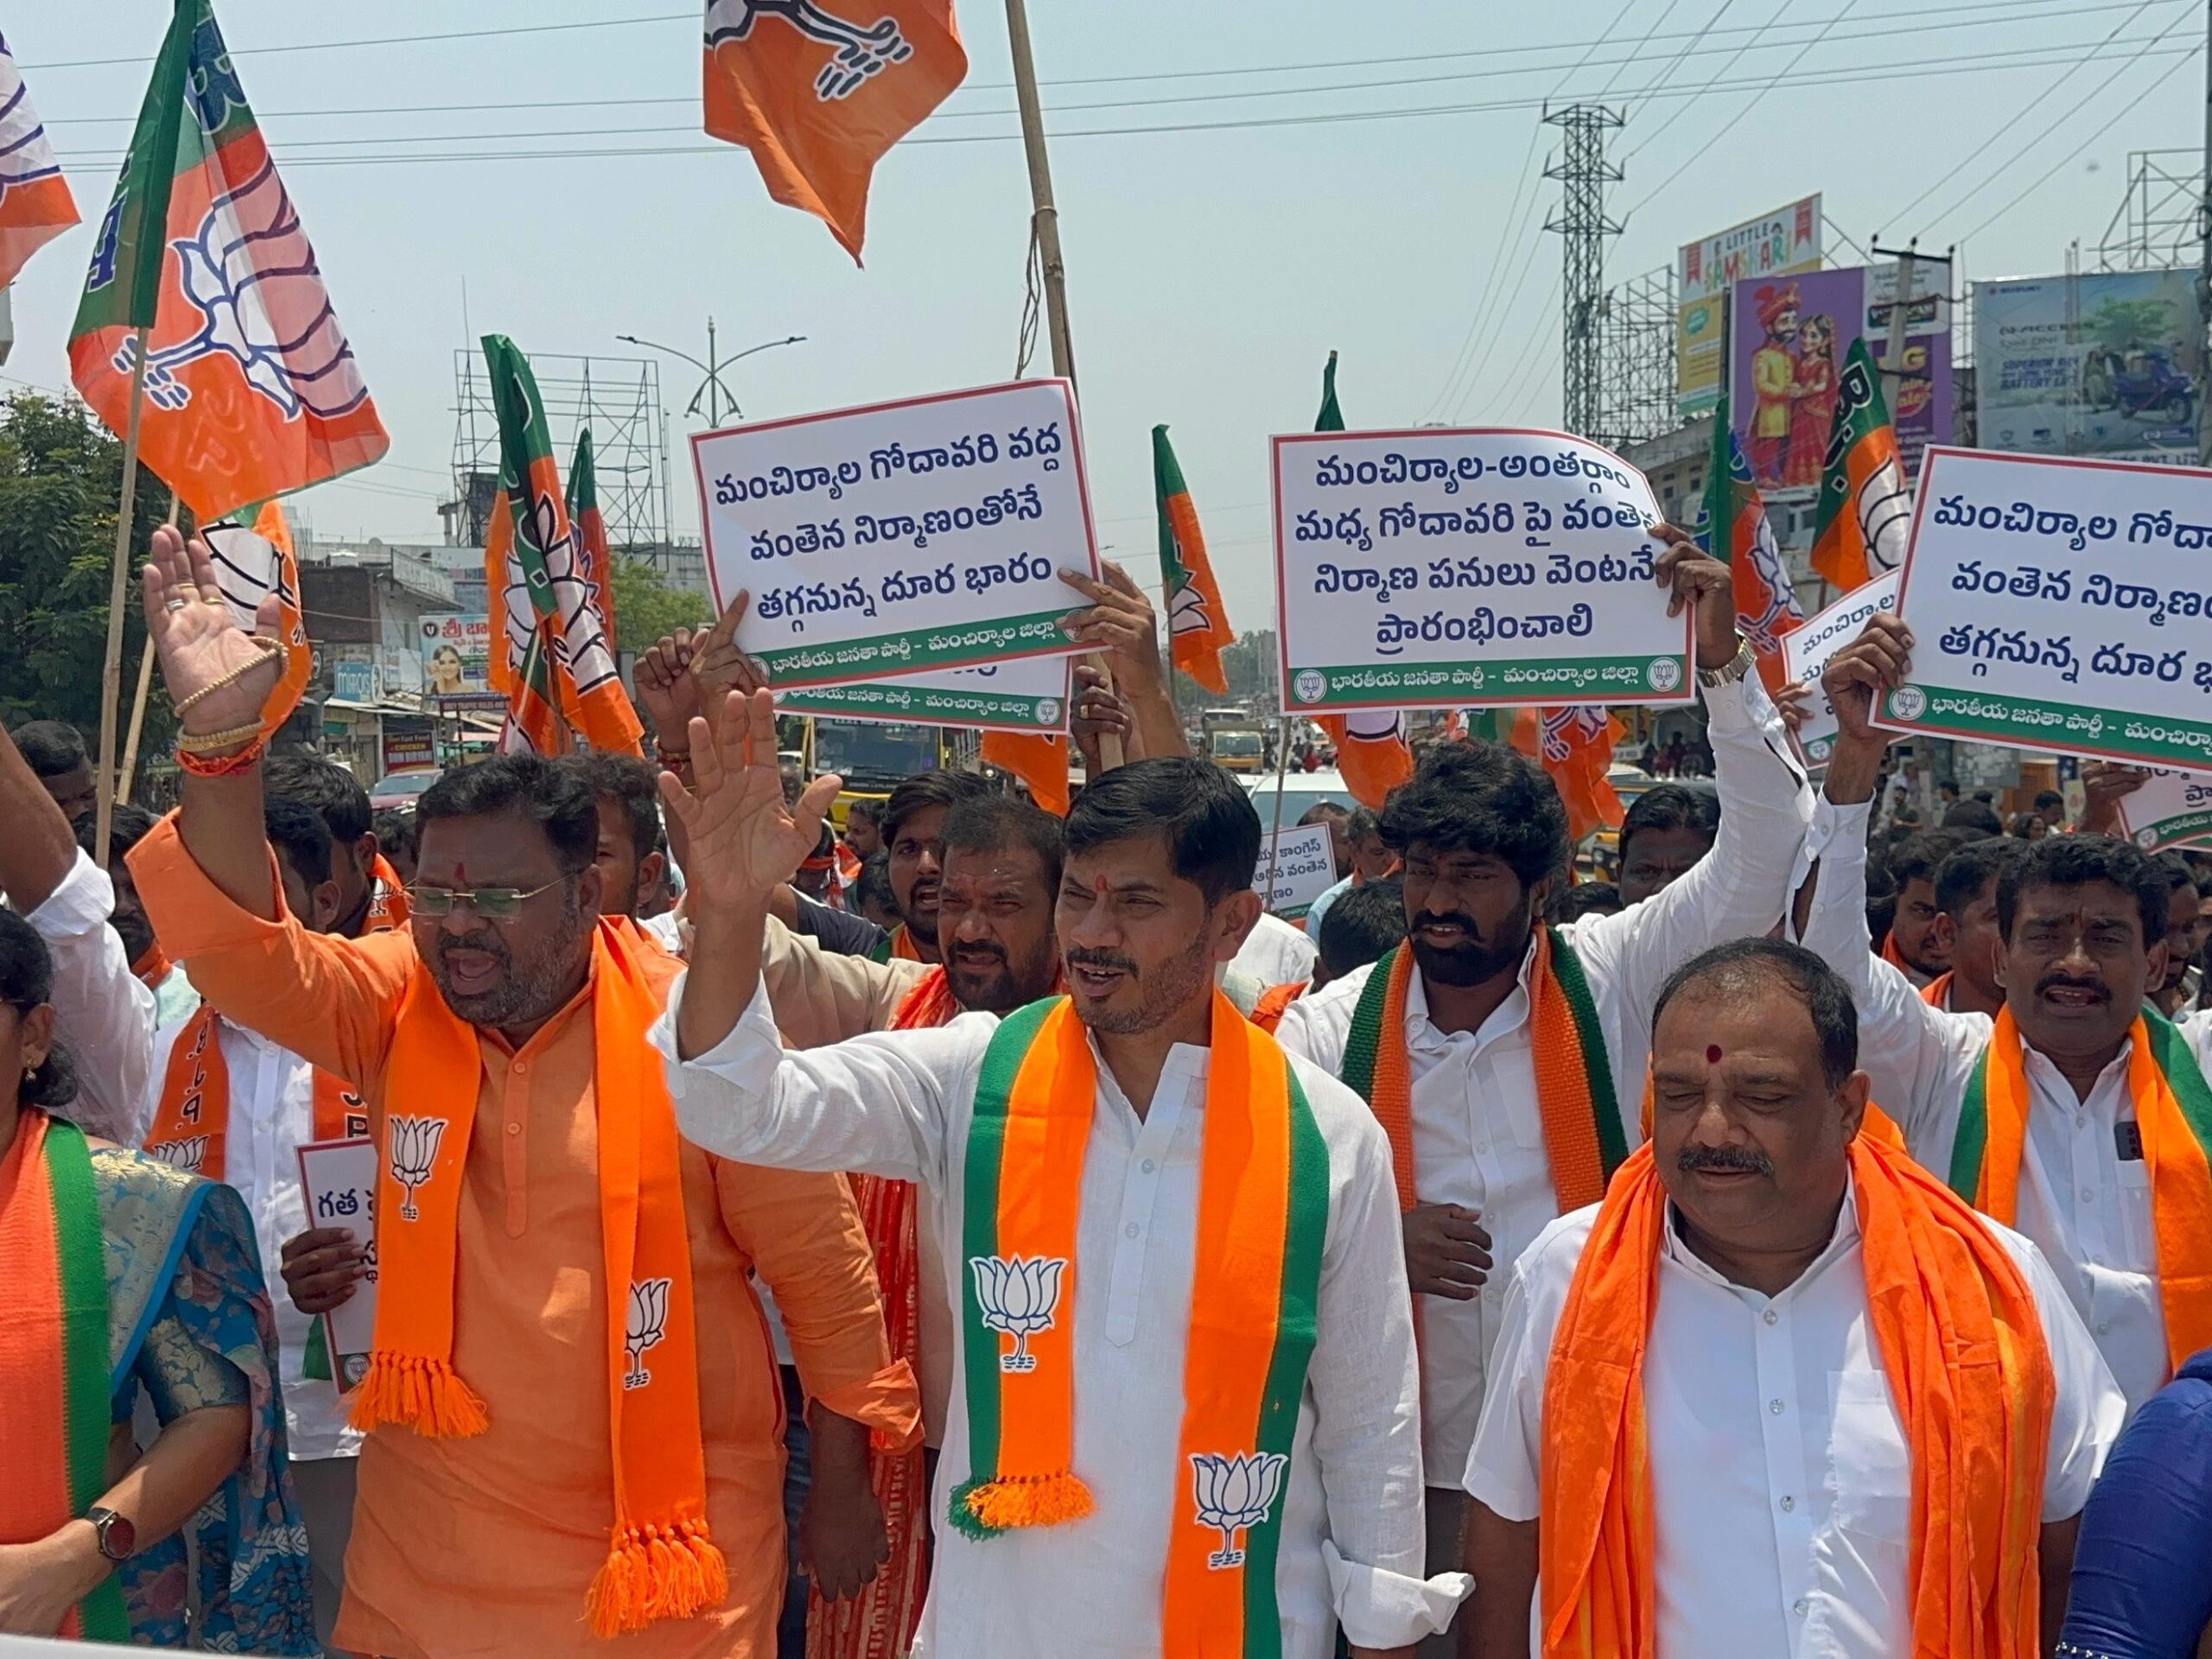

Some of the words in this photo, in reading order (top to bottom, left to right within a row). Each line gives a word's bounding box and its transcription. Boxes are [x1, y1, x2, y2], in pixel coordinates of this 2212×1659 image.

[1726, 222, 1769, 250] LITTLE
[715, 461, 861, 505] మంచిర్యాల
[869, 433, 999, 480] గోదావరి
[1007, 422, 1061, 472] వద్ద
[1315, 451, 1630, 495] మంచిర్యాల-అంతర్గాం
[750, 518, 845, 561] వంతెన
[855, 483, 1043, 549] నిర్మాణంతోనే
[1295, 507, 1373, 552] మధ్య
[1379, 501, 1515, 537] గోదావరి
[1522, 501, 1552, 548] పై
[1934, 494, 2118, 551] మంచిర్యాల
[757, 576, 878, 632] తగ్గనున్న
[881, 563, 956, 603] దూర
[964, 551, 1052, 595] భారం
[1314, 563, 1418, 603] నిర్మాణ
[1427, 556, 1535, 589] పనులు
[1546, 543, 1656, 584] వెంటనే
[1951, 560, 2071, 601] వంతెన
[772, 651, 835, 673] భారతీయ
[836, 646, 879, 664] జనతా
[880, 638, 912, 660] పార్టీ
[927, 627, 1016, 651] మంచిర్యాల
[1019, 621, 1056, 639] జిల్లా
[1376, 600, 1592, 656] ప్రారంభించాలి
[1939, 624, 2080, 684] తగ్గనున్న
[2091, 642, 2187, 682] దూర
[1331, 670, 1401, 692] భారతీయ
[1403, 670, 1450, 686] జనతా
[1452, 666, 1484, 690] పార్టీ
[1503, 667, 1598, 688] మంచిర్యాల
[1601, 666, 1639, 684] జిల్లా
[1931, 698, 2009, 720] భారతీయ
[2011, 708, 2064, 726] జనతా
[2065, 713, 2103, 739] పార్టీ
[318, 1188, 359, 1218] గత
